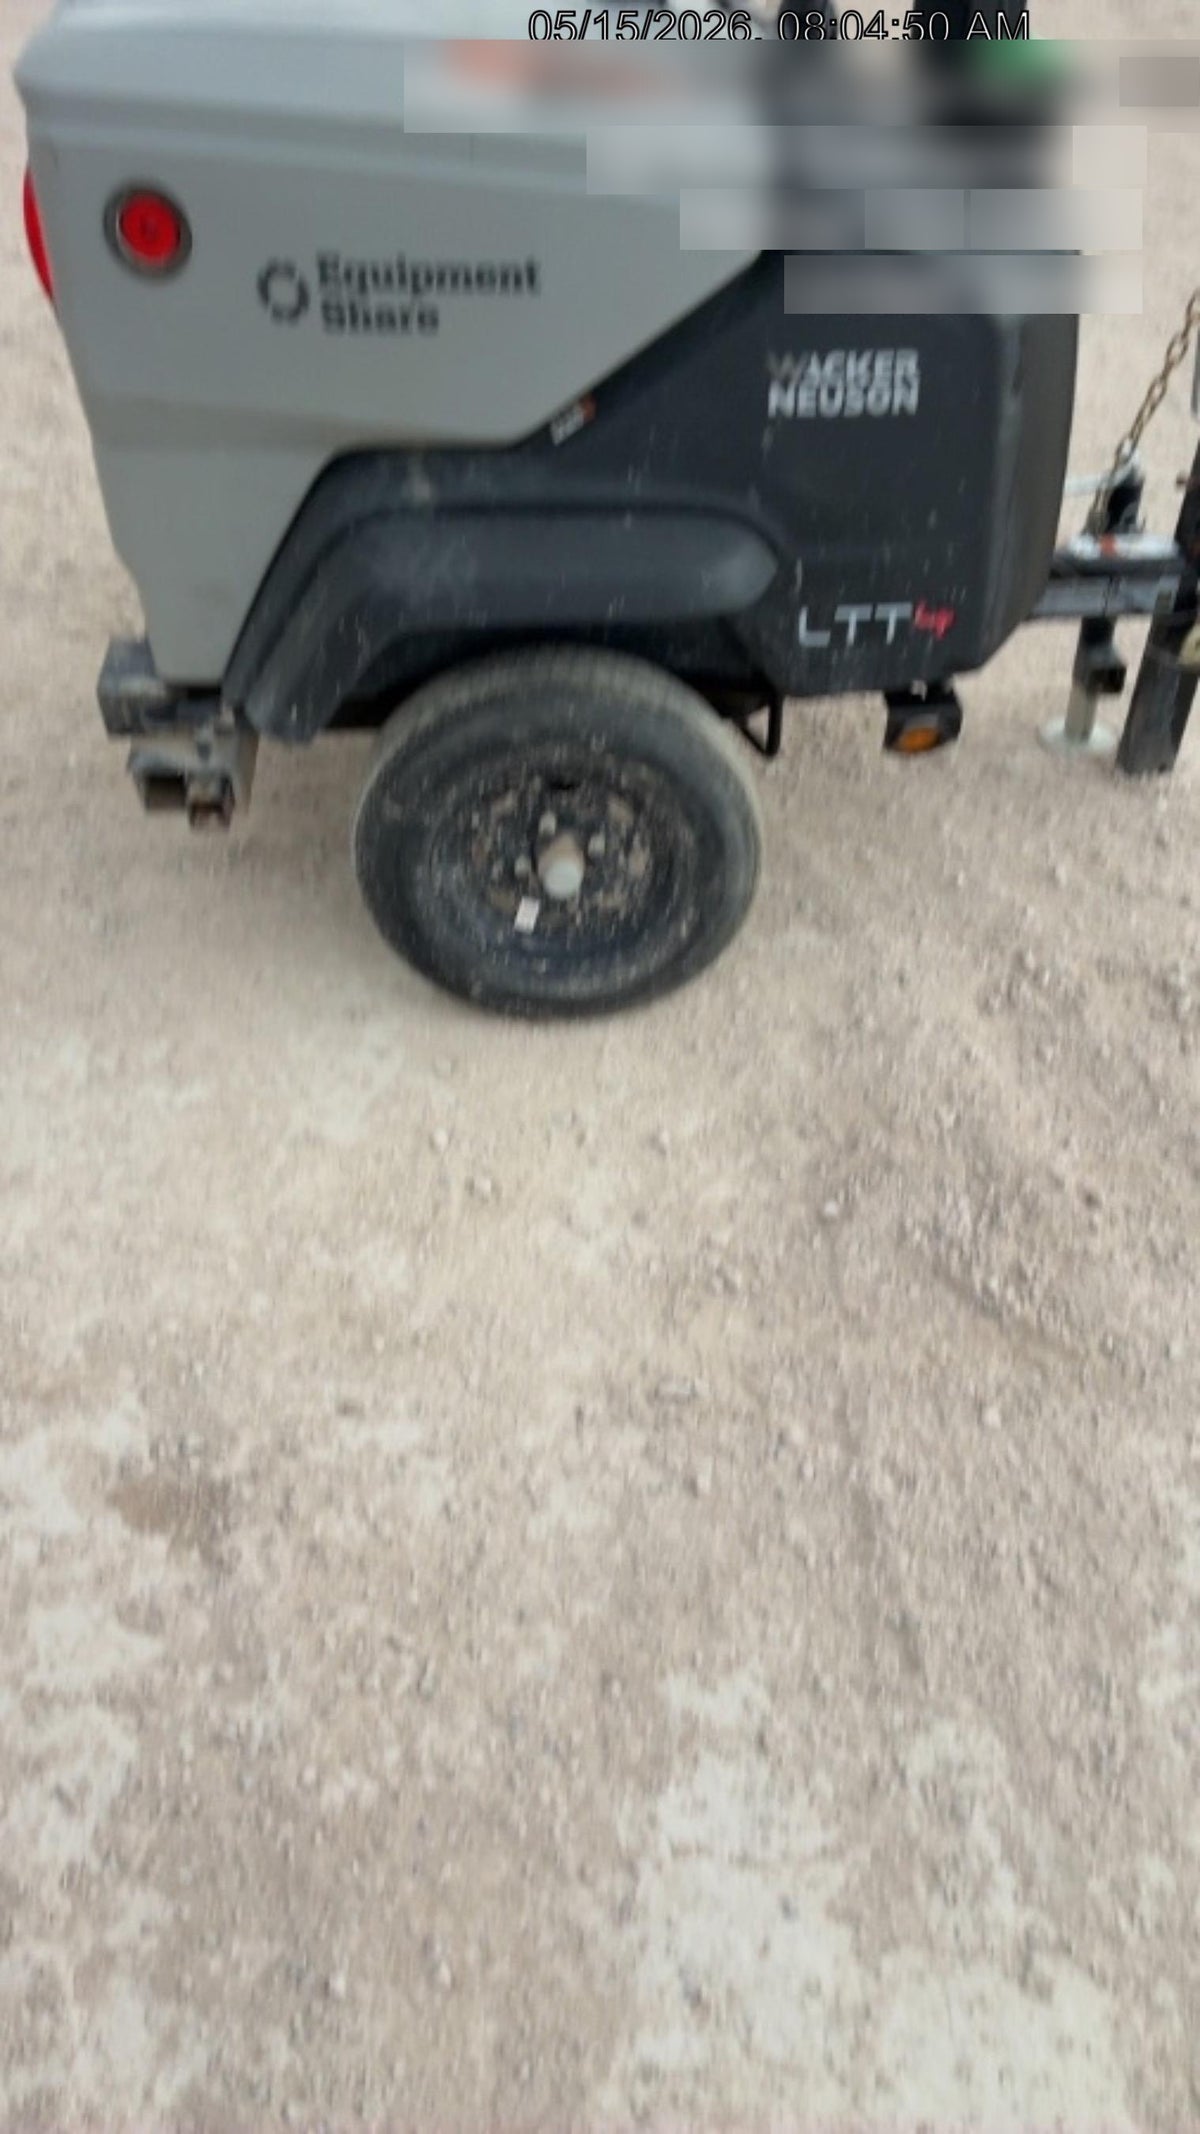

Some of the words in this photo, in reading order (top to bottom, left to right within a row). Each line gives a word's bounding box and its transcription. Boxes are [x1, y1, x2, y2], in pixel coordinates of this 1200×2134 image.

[316, 252, 540, 297] Equipment
[320, 300, 440, 335] Share
[764, 349, 920, 382] WACKER
[766, 377, 920, 418] NEUSON
